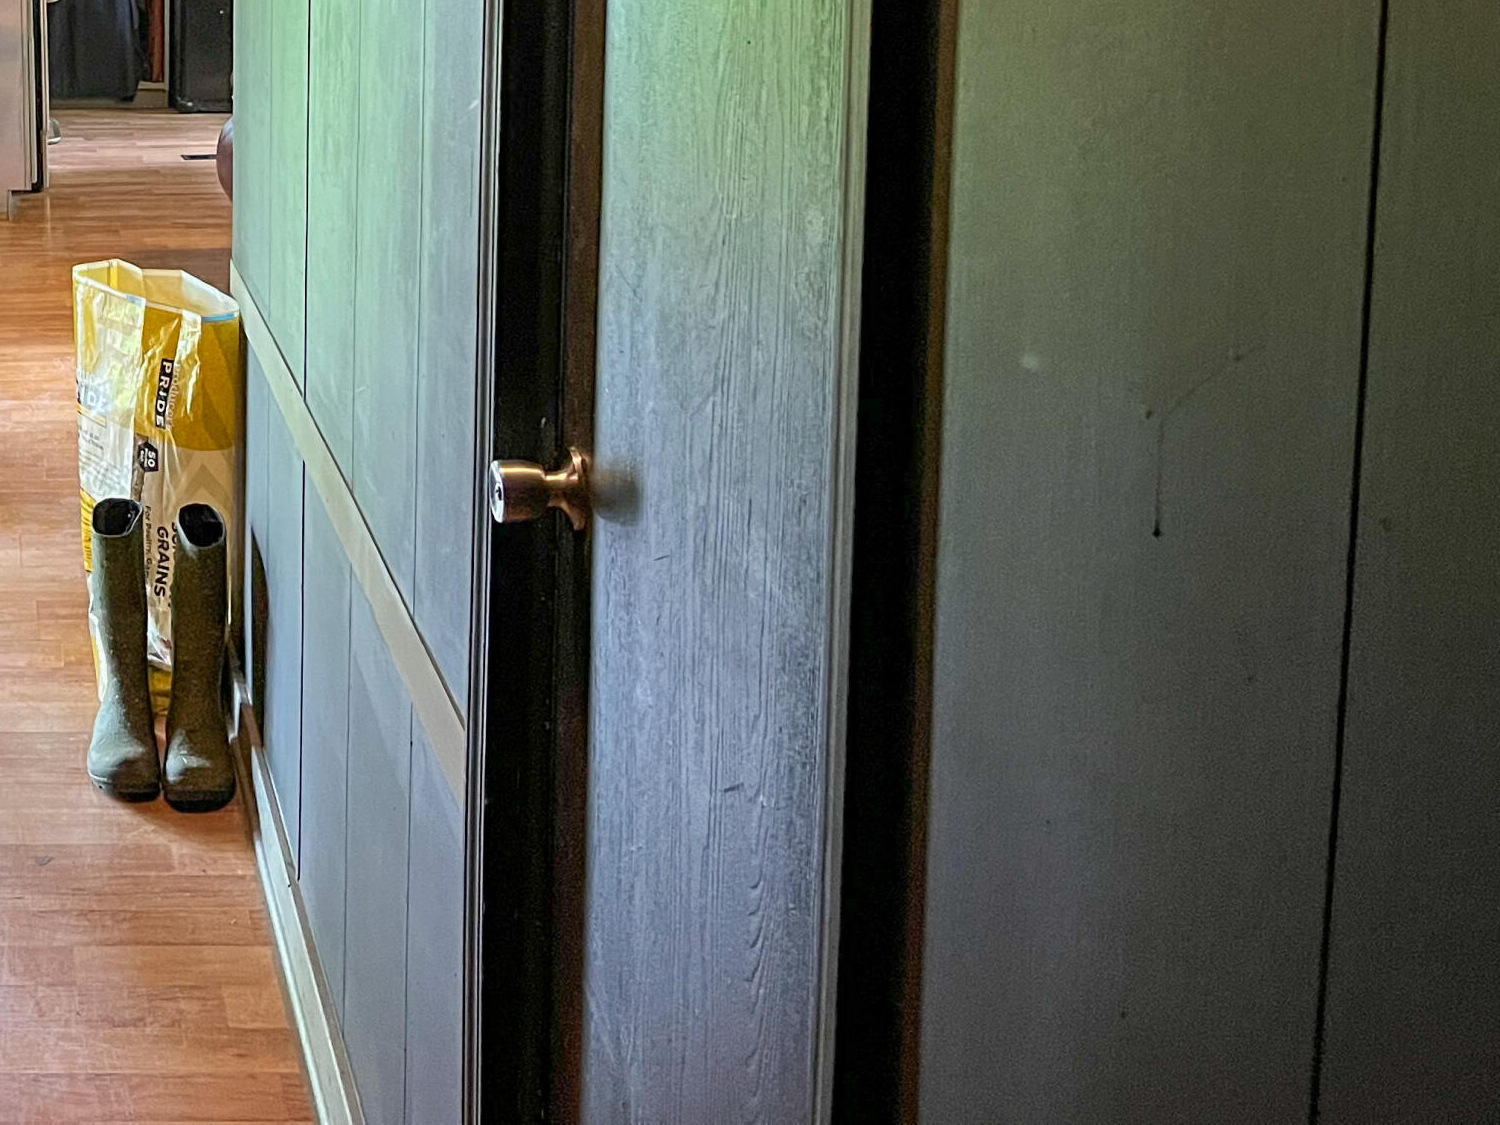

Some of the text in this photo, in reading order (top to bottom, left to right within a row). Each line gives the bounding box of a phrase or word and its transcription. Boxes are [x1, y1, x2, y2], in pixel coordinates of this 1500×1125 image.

[155, 361, 173, 426] PRIDE
[147, 450, 157, 468] 50
[154, 525, 170, 597] GRAINS
